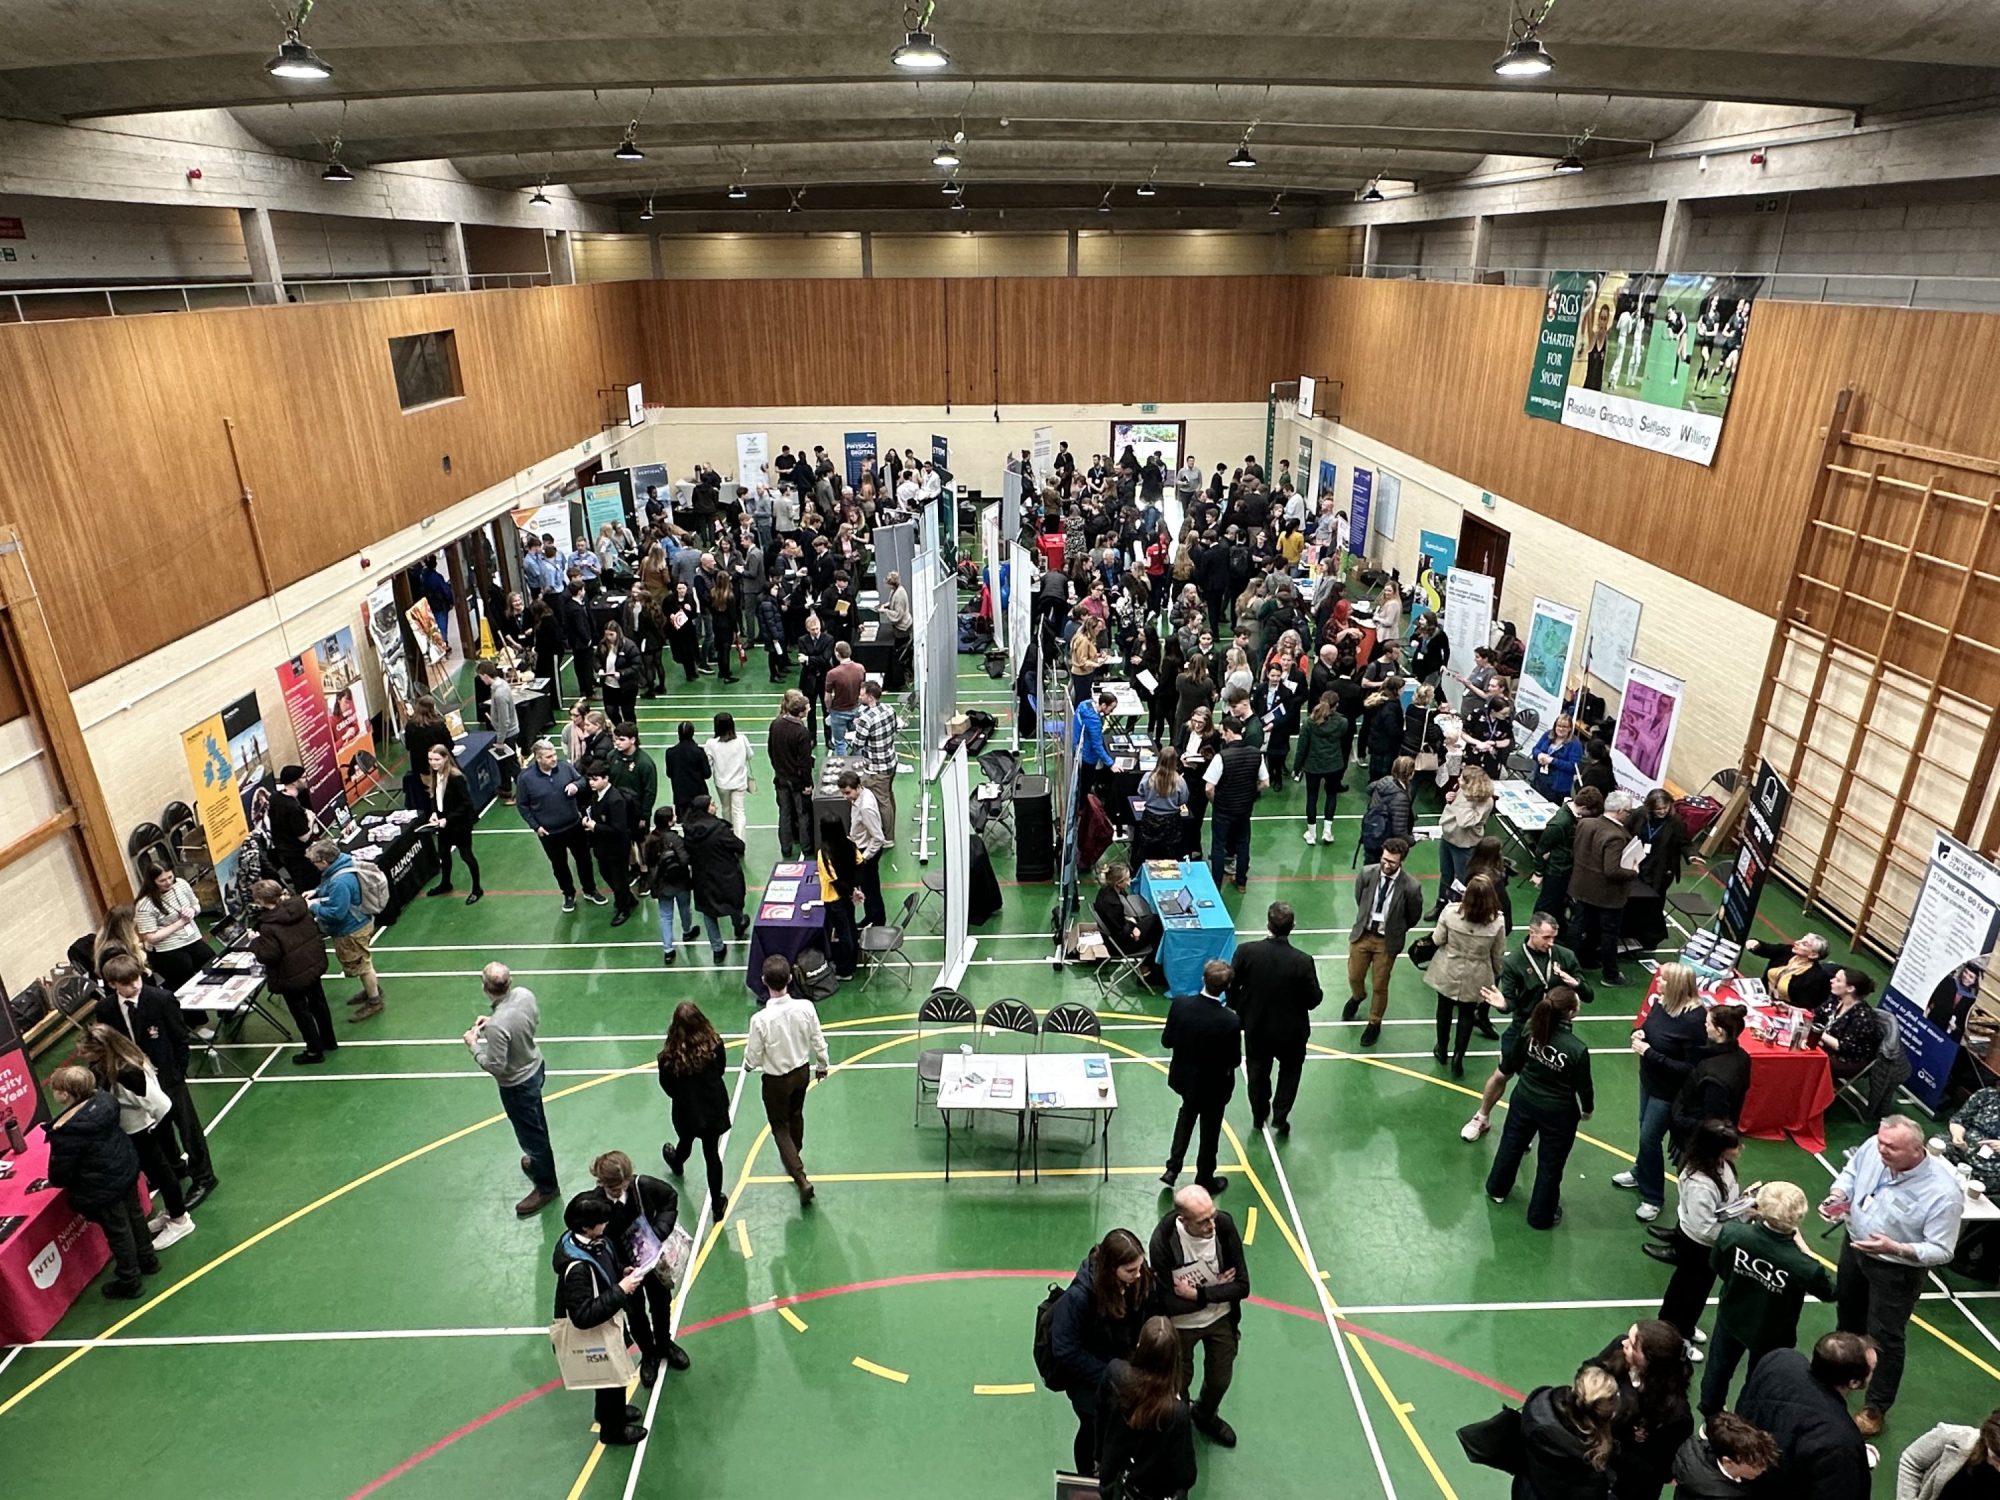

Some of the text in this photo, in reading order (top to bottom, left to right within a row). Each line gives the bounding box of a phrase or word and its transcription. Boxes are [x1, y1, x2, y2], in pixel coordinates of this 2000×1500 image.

[1558, 292, 1581, 316] RGS
[1541, 329, 1575, 348] CHARTER
[1546, 351, 1562, 366] FOR
[1540, 369, 1563, 387] SPORT
[1567, 397, 1596, 418] Resolute
[1600, 405, 1634, 429] Gracious
[1639, 415, 1671, 438] Selfless
[1680, 424, 1711, 450] Willing
[390, 840, 423, 879] FALMOUTH
[1948, 861, 1972, 880] CENTRE
[1951, 854, 1986, 881] UNIVERSITY
[1932, 872, 1990, 917] STAY NEAR, GO FAR
[1904, 1010, 1919, 1023] find
[1917, 1020, 1928, 1030] out
[1926, 1027, 1945, 1044] more?
[1528, 1036, 1568, 1068] RGS
[0, 1084, 29, 1105] Year
[57, 1213, 86, 1243] Nottin
[61, 1221, 89, 1253] Univer
[34, 1251, 56, 1278] NTU
[1734, 1246, 1789, 1288] RGS
[1733, 1265, 1783, 1295] WORCESTER
[586, 1353, 609, 1364] RSM
